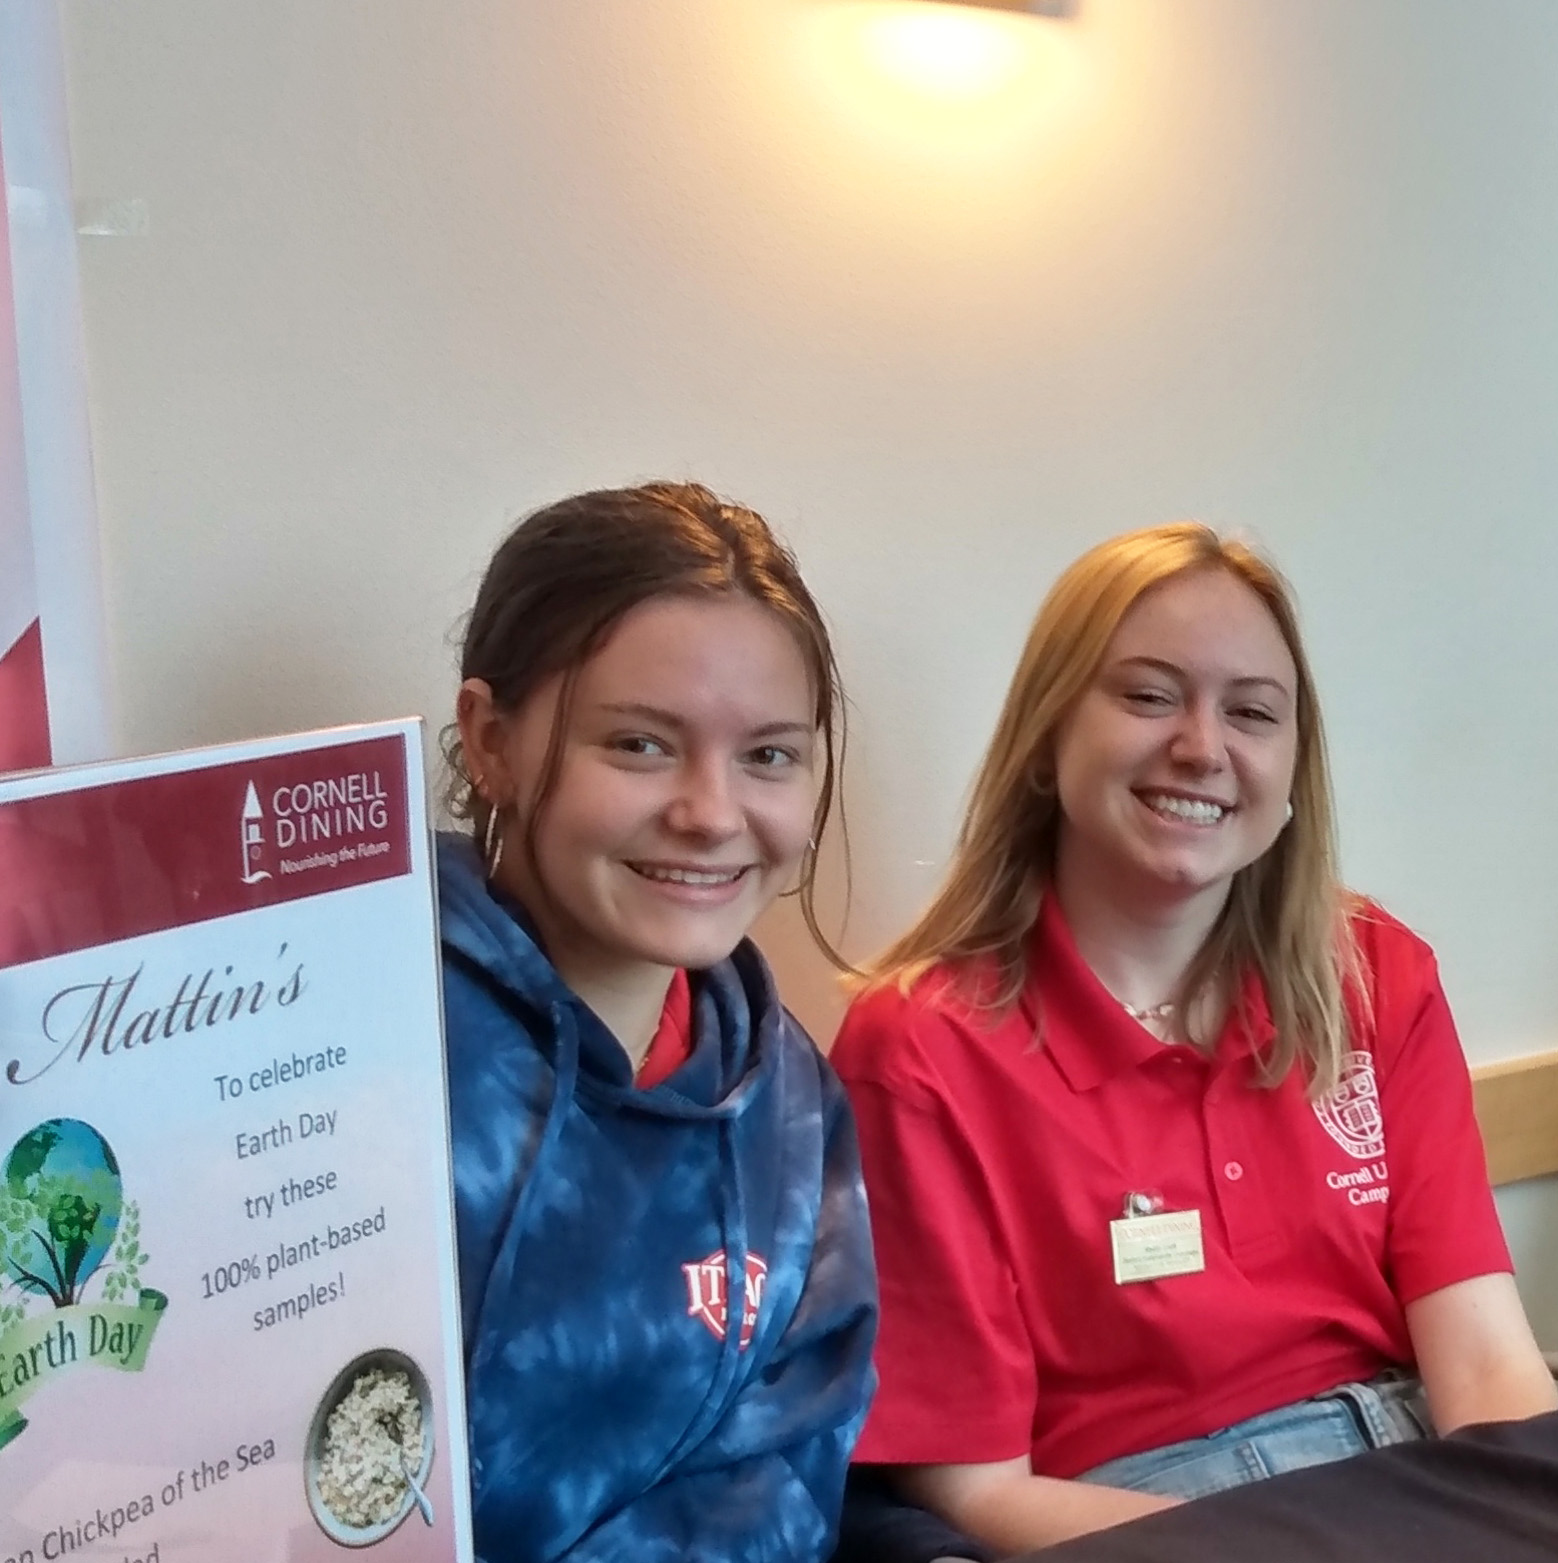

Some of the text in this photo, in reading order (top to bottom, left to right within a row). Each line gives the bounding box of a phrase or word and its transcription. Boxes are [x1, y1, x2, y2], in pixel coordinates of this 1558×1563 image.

[273, 771, 388, 817] CORNELL
[277, 800, 388, 848] DINING
[280, 842, 391, 875] Nourishing the Future
[6, 942, 310, 1085] Mattin's
[214, 1043, 348, 1102] To celebrate
[236, 1107, 338, 1160] Earth Day
[244, 1168, 338, 1220] try these
[1326, 1165, 1373, 1190] Cornell
[200, 1206, 387, 1299] 100% plant-based
[253, 1271, 347, 1332] samples!
[0, 1313, 144, 1398] Earth Day
[42, 1494, 155, 1561] Chickpea
[161, 1470, 185, 1506] of
[191, 1459, 230, 1493] the
[236, 1438, 276, 1472] Sea
